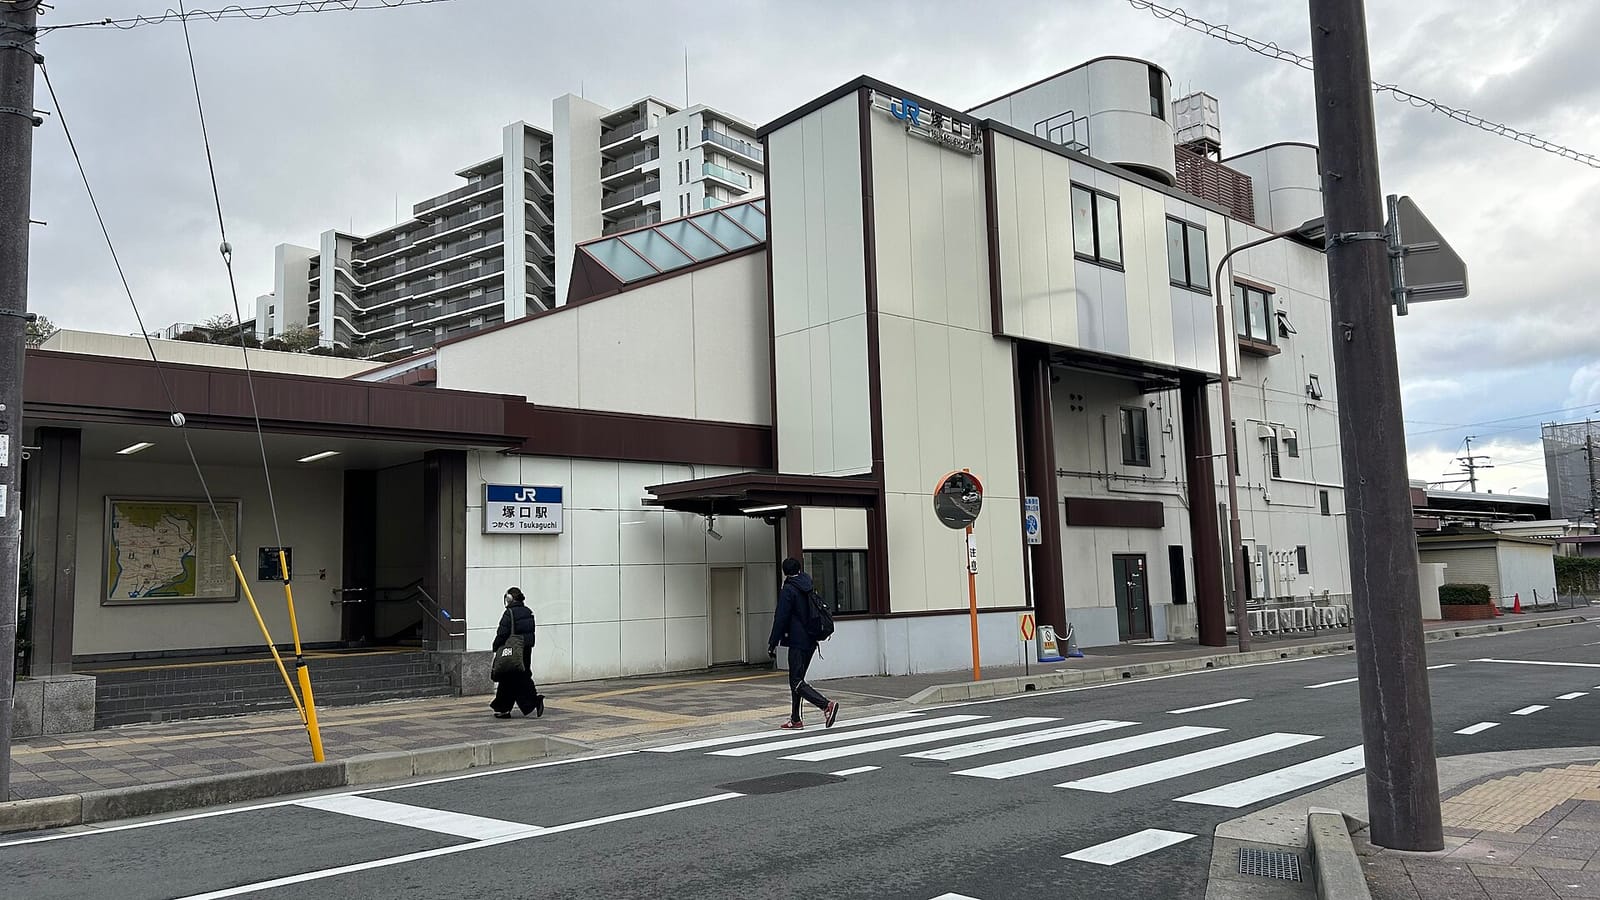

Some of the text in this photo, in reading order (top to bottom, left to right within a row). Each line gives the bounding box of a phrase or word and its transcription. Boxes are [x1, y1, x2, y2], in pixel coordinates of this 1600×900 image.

[891, 97, 920, 126] JR
[515, 488, 536, 501] JR
[502, 505, 547, 518] 塚口駅
[492, 521, 557, 530] つかぐち Tsukaguchi
[970, 548, 977, 571] 注意
